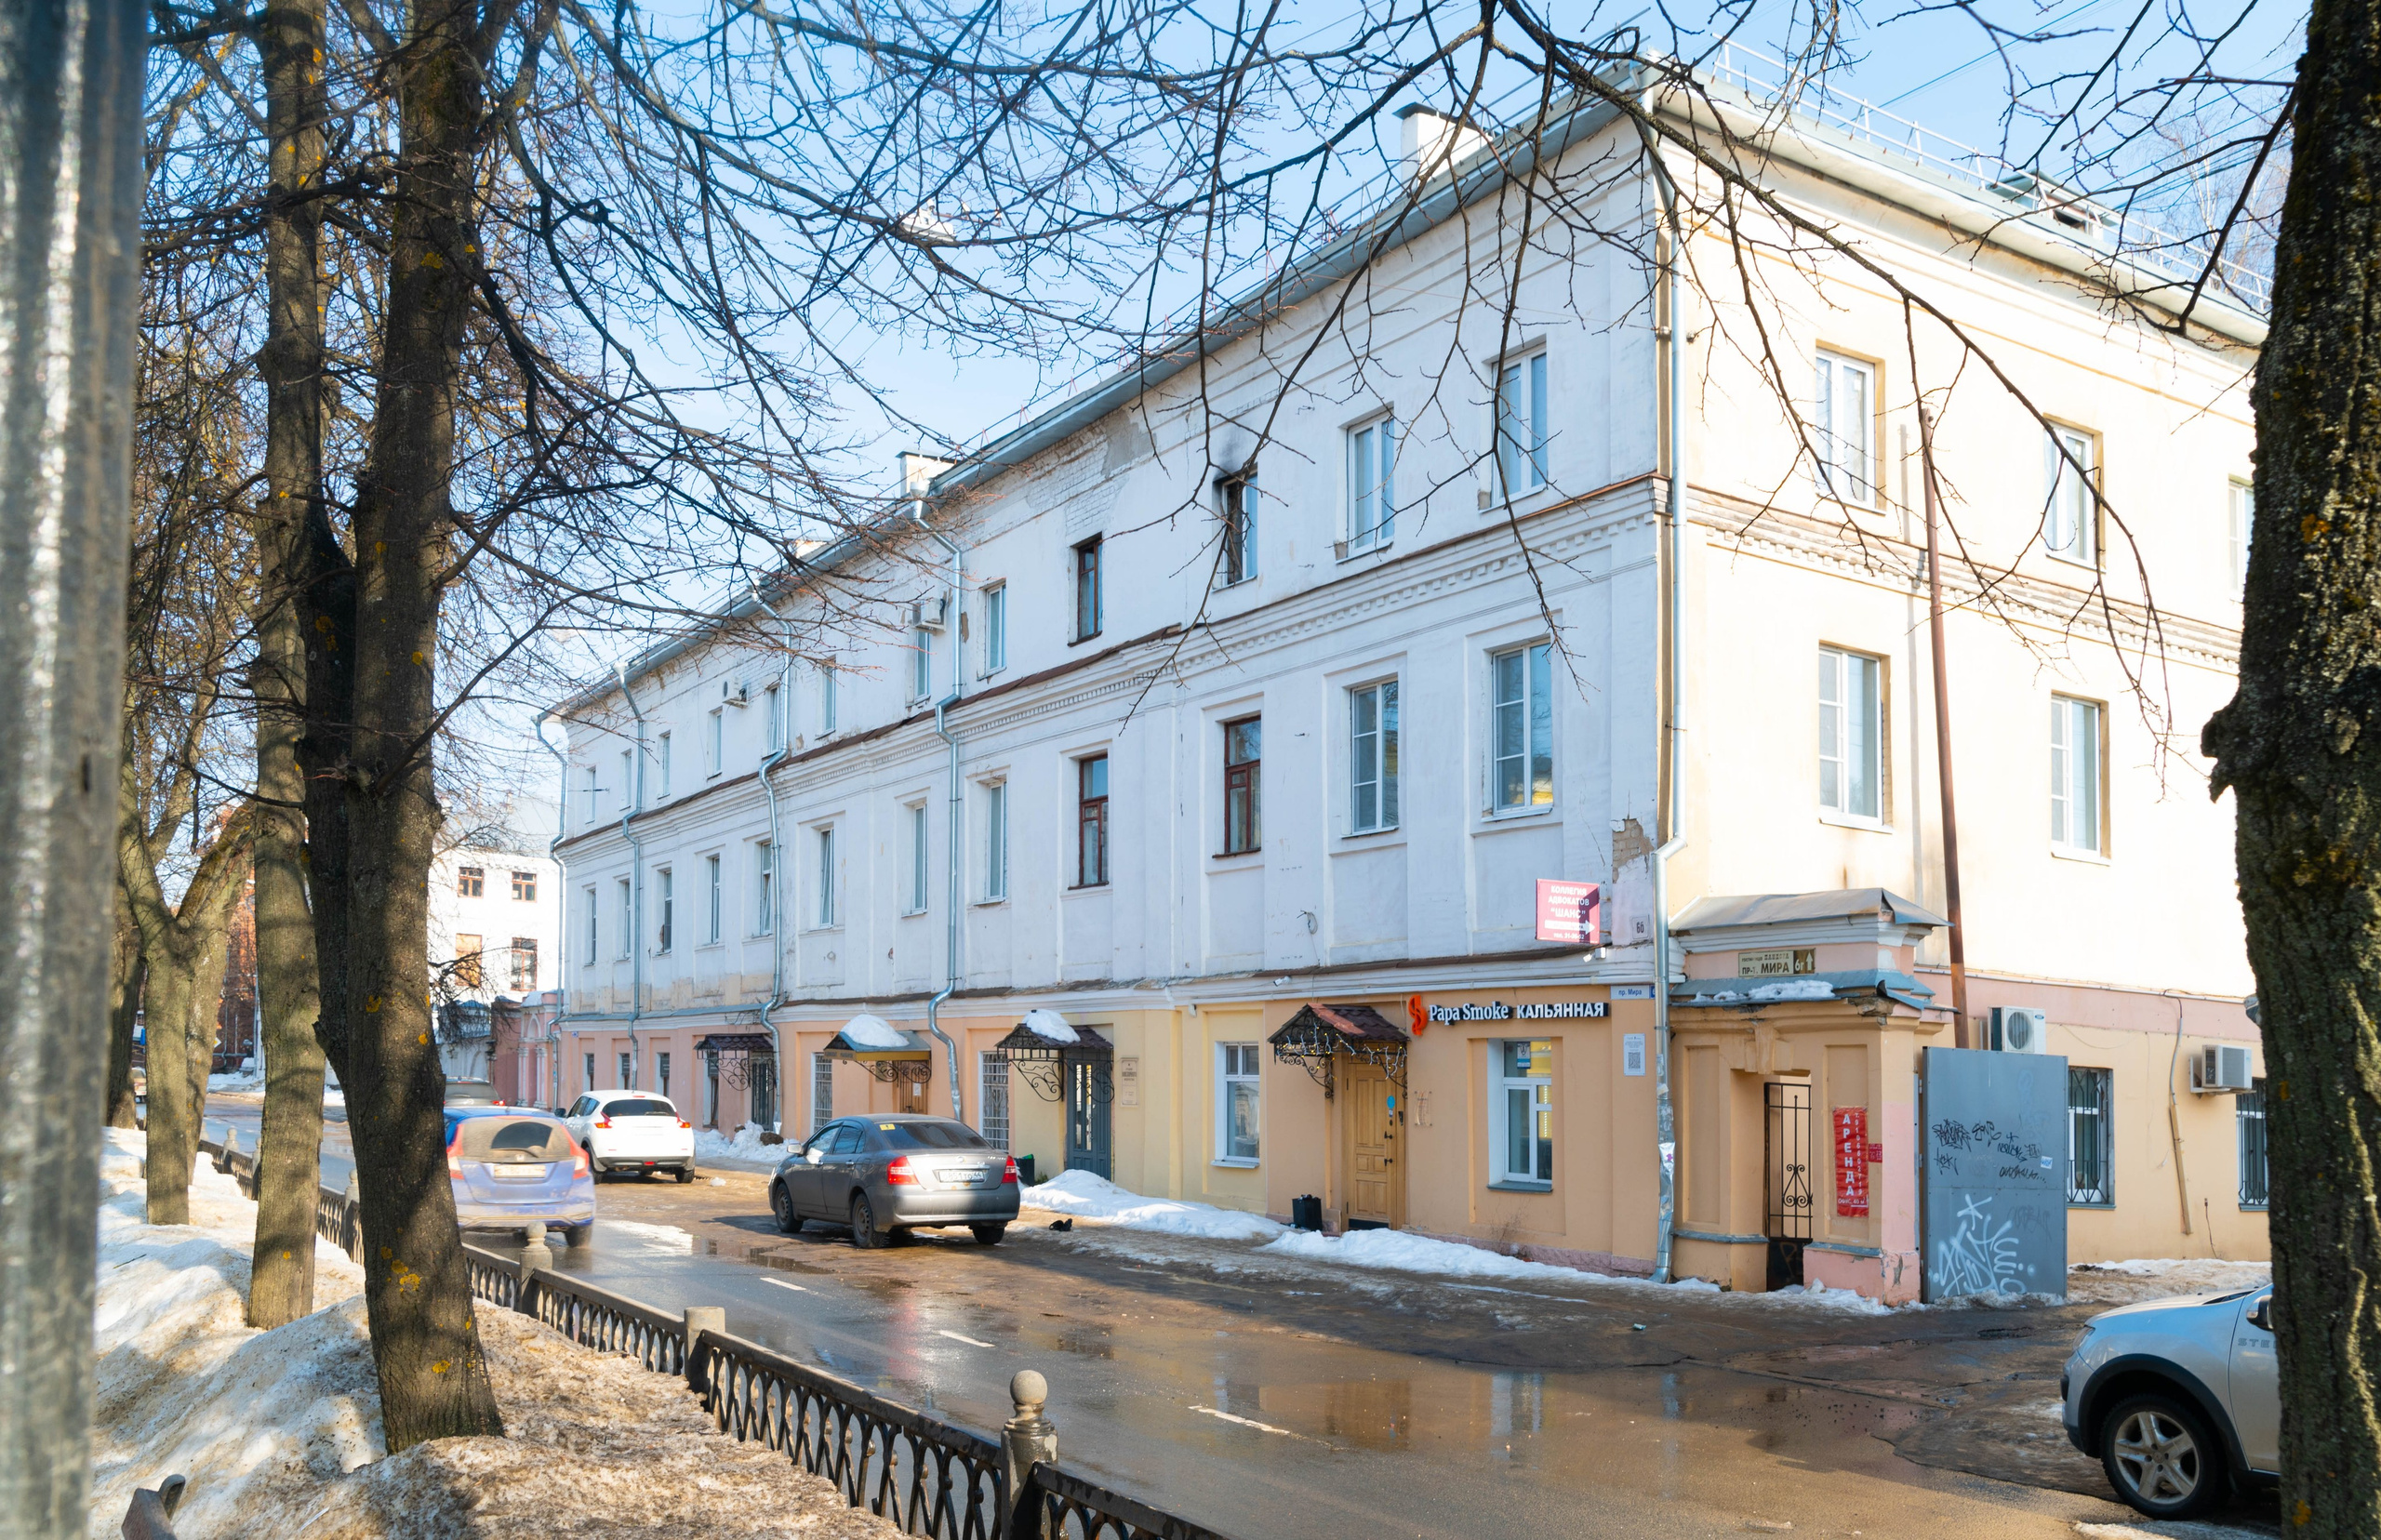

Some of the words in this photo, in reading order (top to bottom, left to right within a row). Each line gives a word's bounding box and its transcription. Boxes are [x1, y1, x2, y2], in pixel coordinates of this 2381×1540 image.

[1550, 885, 1587, 896] КОЛЛЕГИЯ
[1548, 896, 1590, 906] АДВОКАТОВ
[1761, 962, 1789, 974] МИРА
[1429, 1003, 1460, 1026] Papa
[1462, 1001, 1510, 1020] Smoke
[1517, 1002, 1604, 1019] КАЛЬЯННАЯ
[1842, 1113, 1856, 1196] АРЕНДА
[2238, 1337, 2276, 1348] STE
